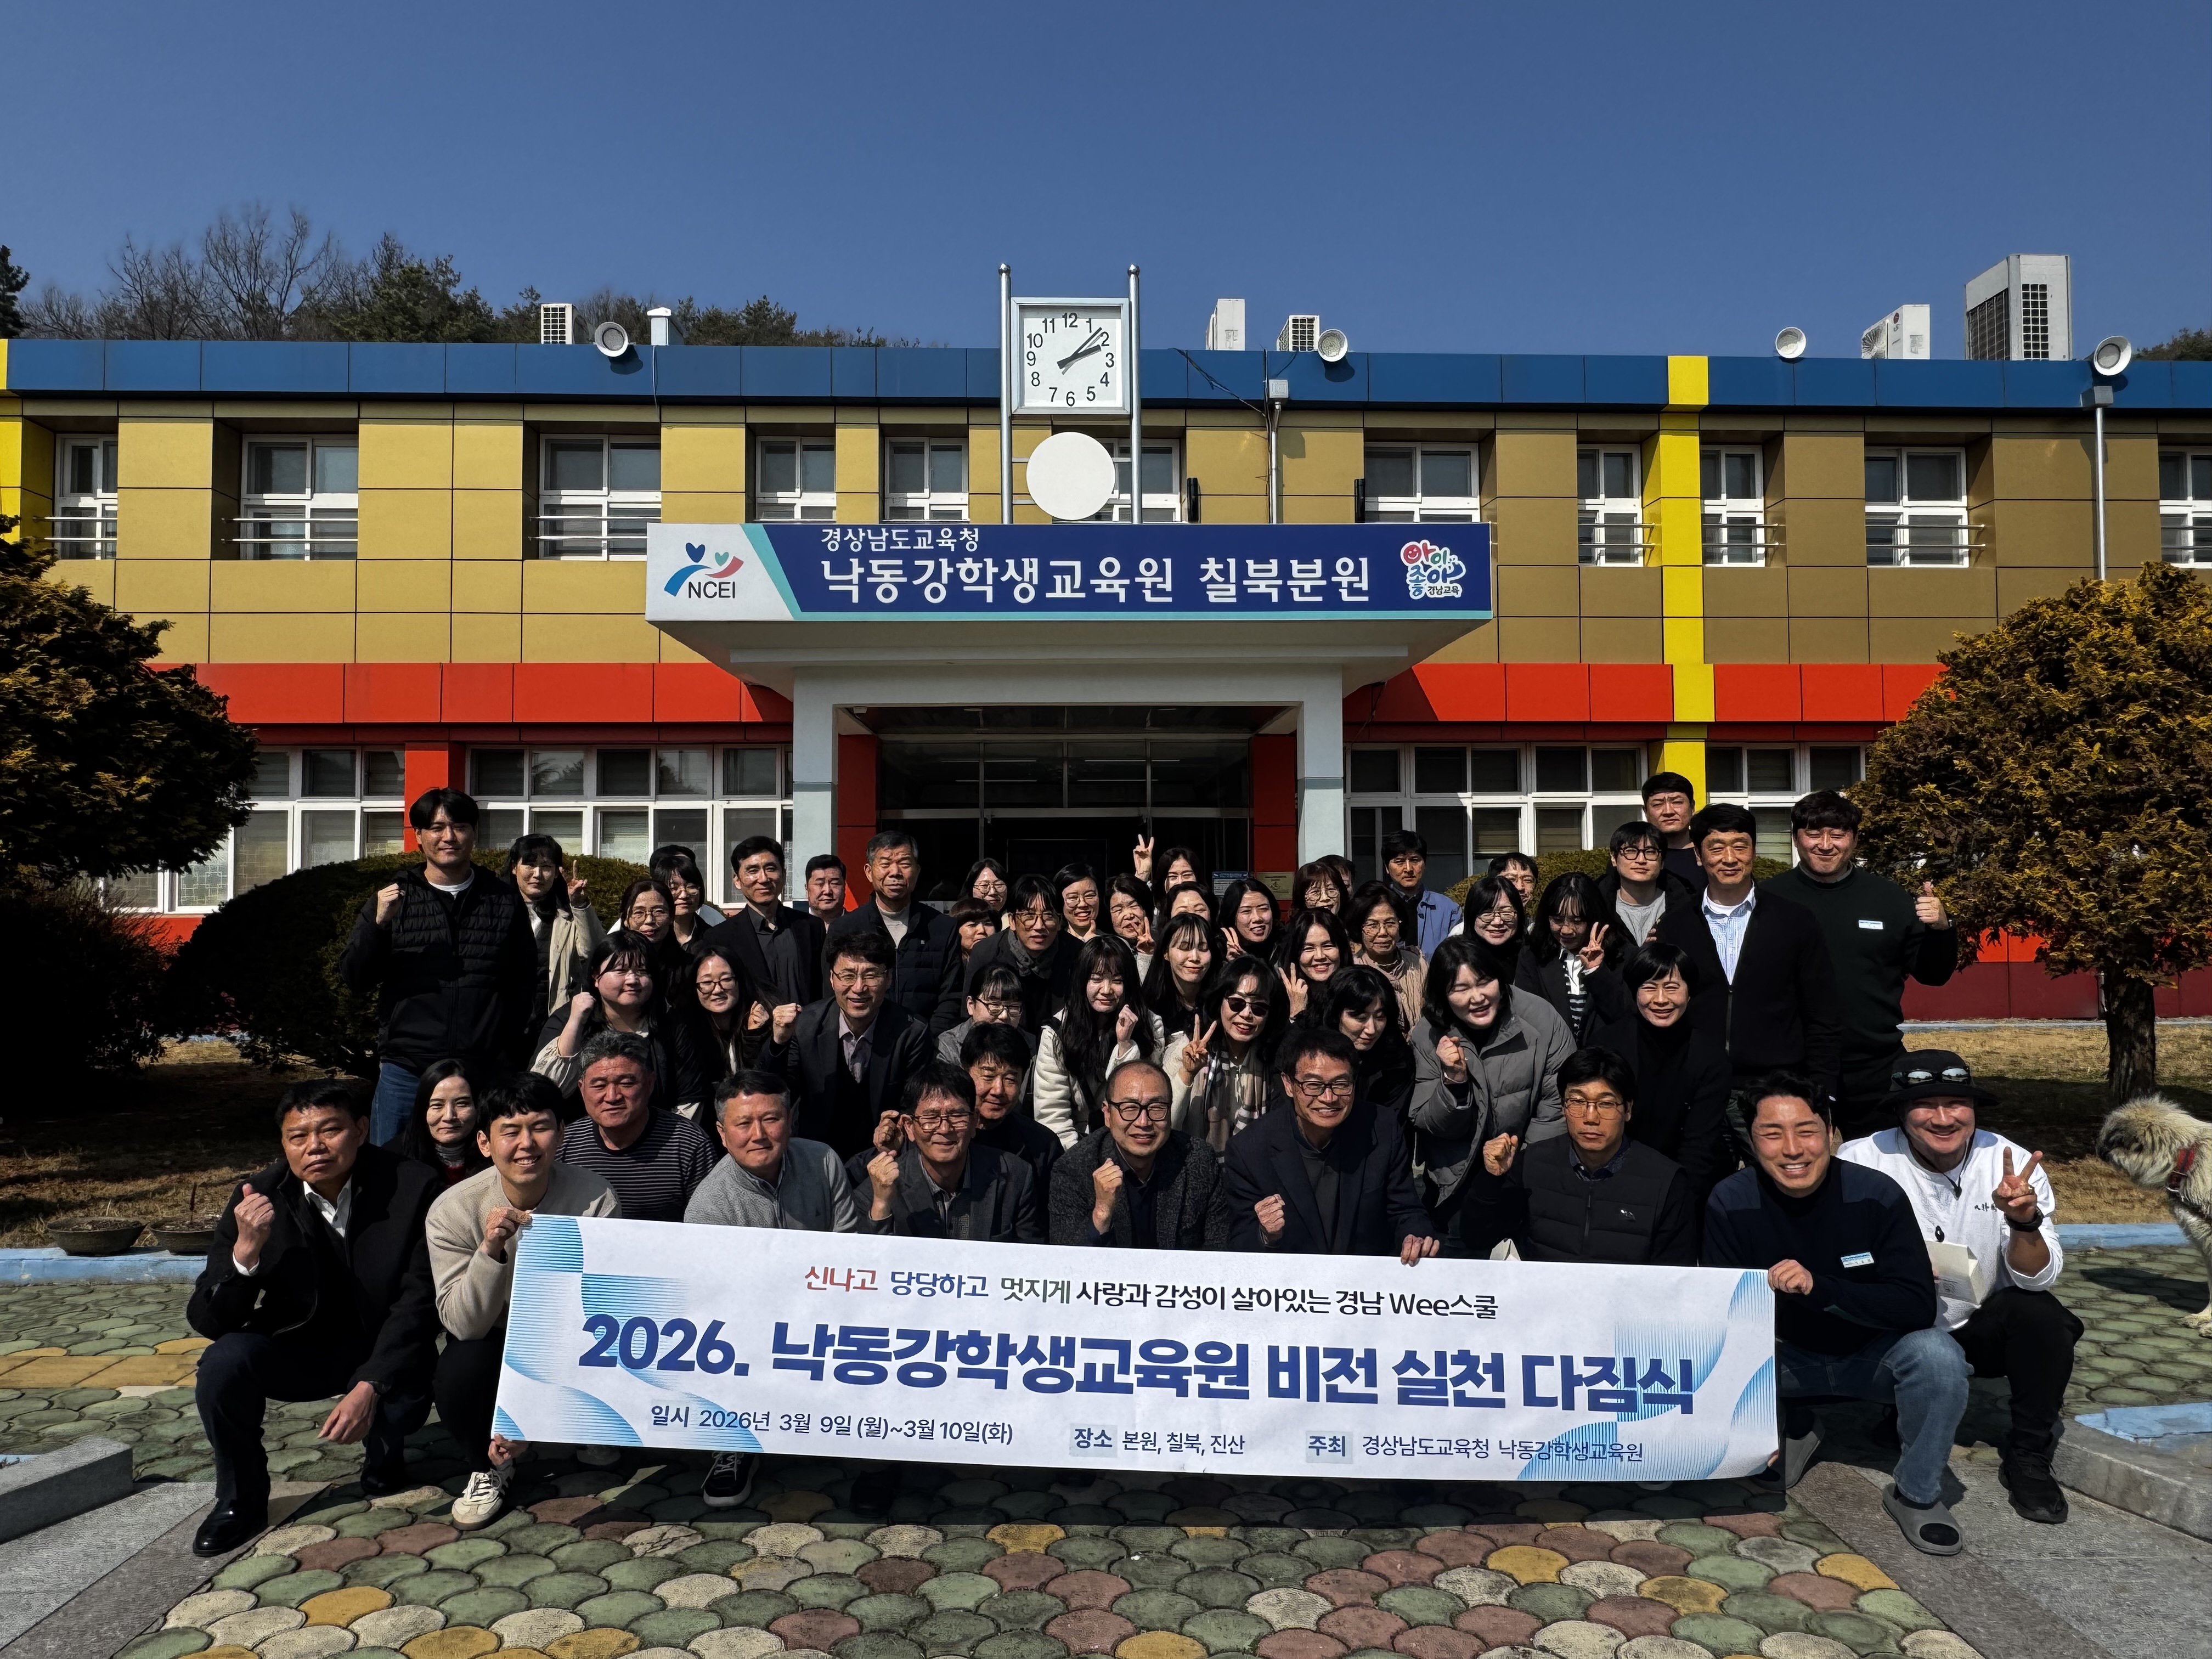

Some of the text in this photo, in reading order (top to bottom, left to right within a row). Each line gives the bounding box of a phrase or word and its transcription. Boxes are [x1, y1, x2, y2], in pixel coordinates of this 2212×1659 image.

[1042, 318, 1055, 333] 11
[1062, 313, 1078, 328] 12
[1086, 318, 1092, 333] 1
[1027, 333, 1043, 348] 10
[1101, 331, 1110, 346] 2
[1026, 351, 1036, 366] 9
[1105, 353, 1114, 368] 3
[1031, 371, 1040, 387] 8
[1100, 372, 1109, 387] 4
[1048, 387, 1058, 402] 7
[1066, 391, 1075, 407] 6
[1086, 386, 1096, 401] 5
[821, 527, 979, 552] 경상남도교육청
[1403, 542, 1447, 565] 아이
[821, 557, 1369, 603] 낙동강학생교육원 칠북분원
[688, 581, 736, 599] NCEI
[1427, 585, 1460, 595] 경남교육
[804, 1266, 1498, 1319] 신나고 당당하고 멋지게 사랑과 감성이 살아있는 경남 Wee스쿨
[578, 1313, 1694, 1414] 2026. 낙동강학생교육원 비전 실천 다짐식
[651, 1405, 690, 1427] 일시
[698, 1410, 770, 1431] 2026년
[779, 1413, 811, 1434] 3월
[939, 1421, 1013, 1446] 10일(화)
[1074, 1427, 1246, 1456] 장소 본원, 칠북, 진산
[1308, 1435, 1643, 1463] 주최 경상남도교육청 낙동강학생교육원
